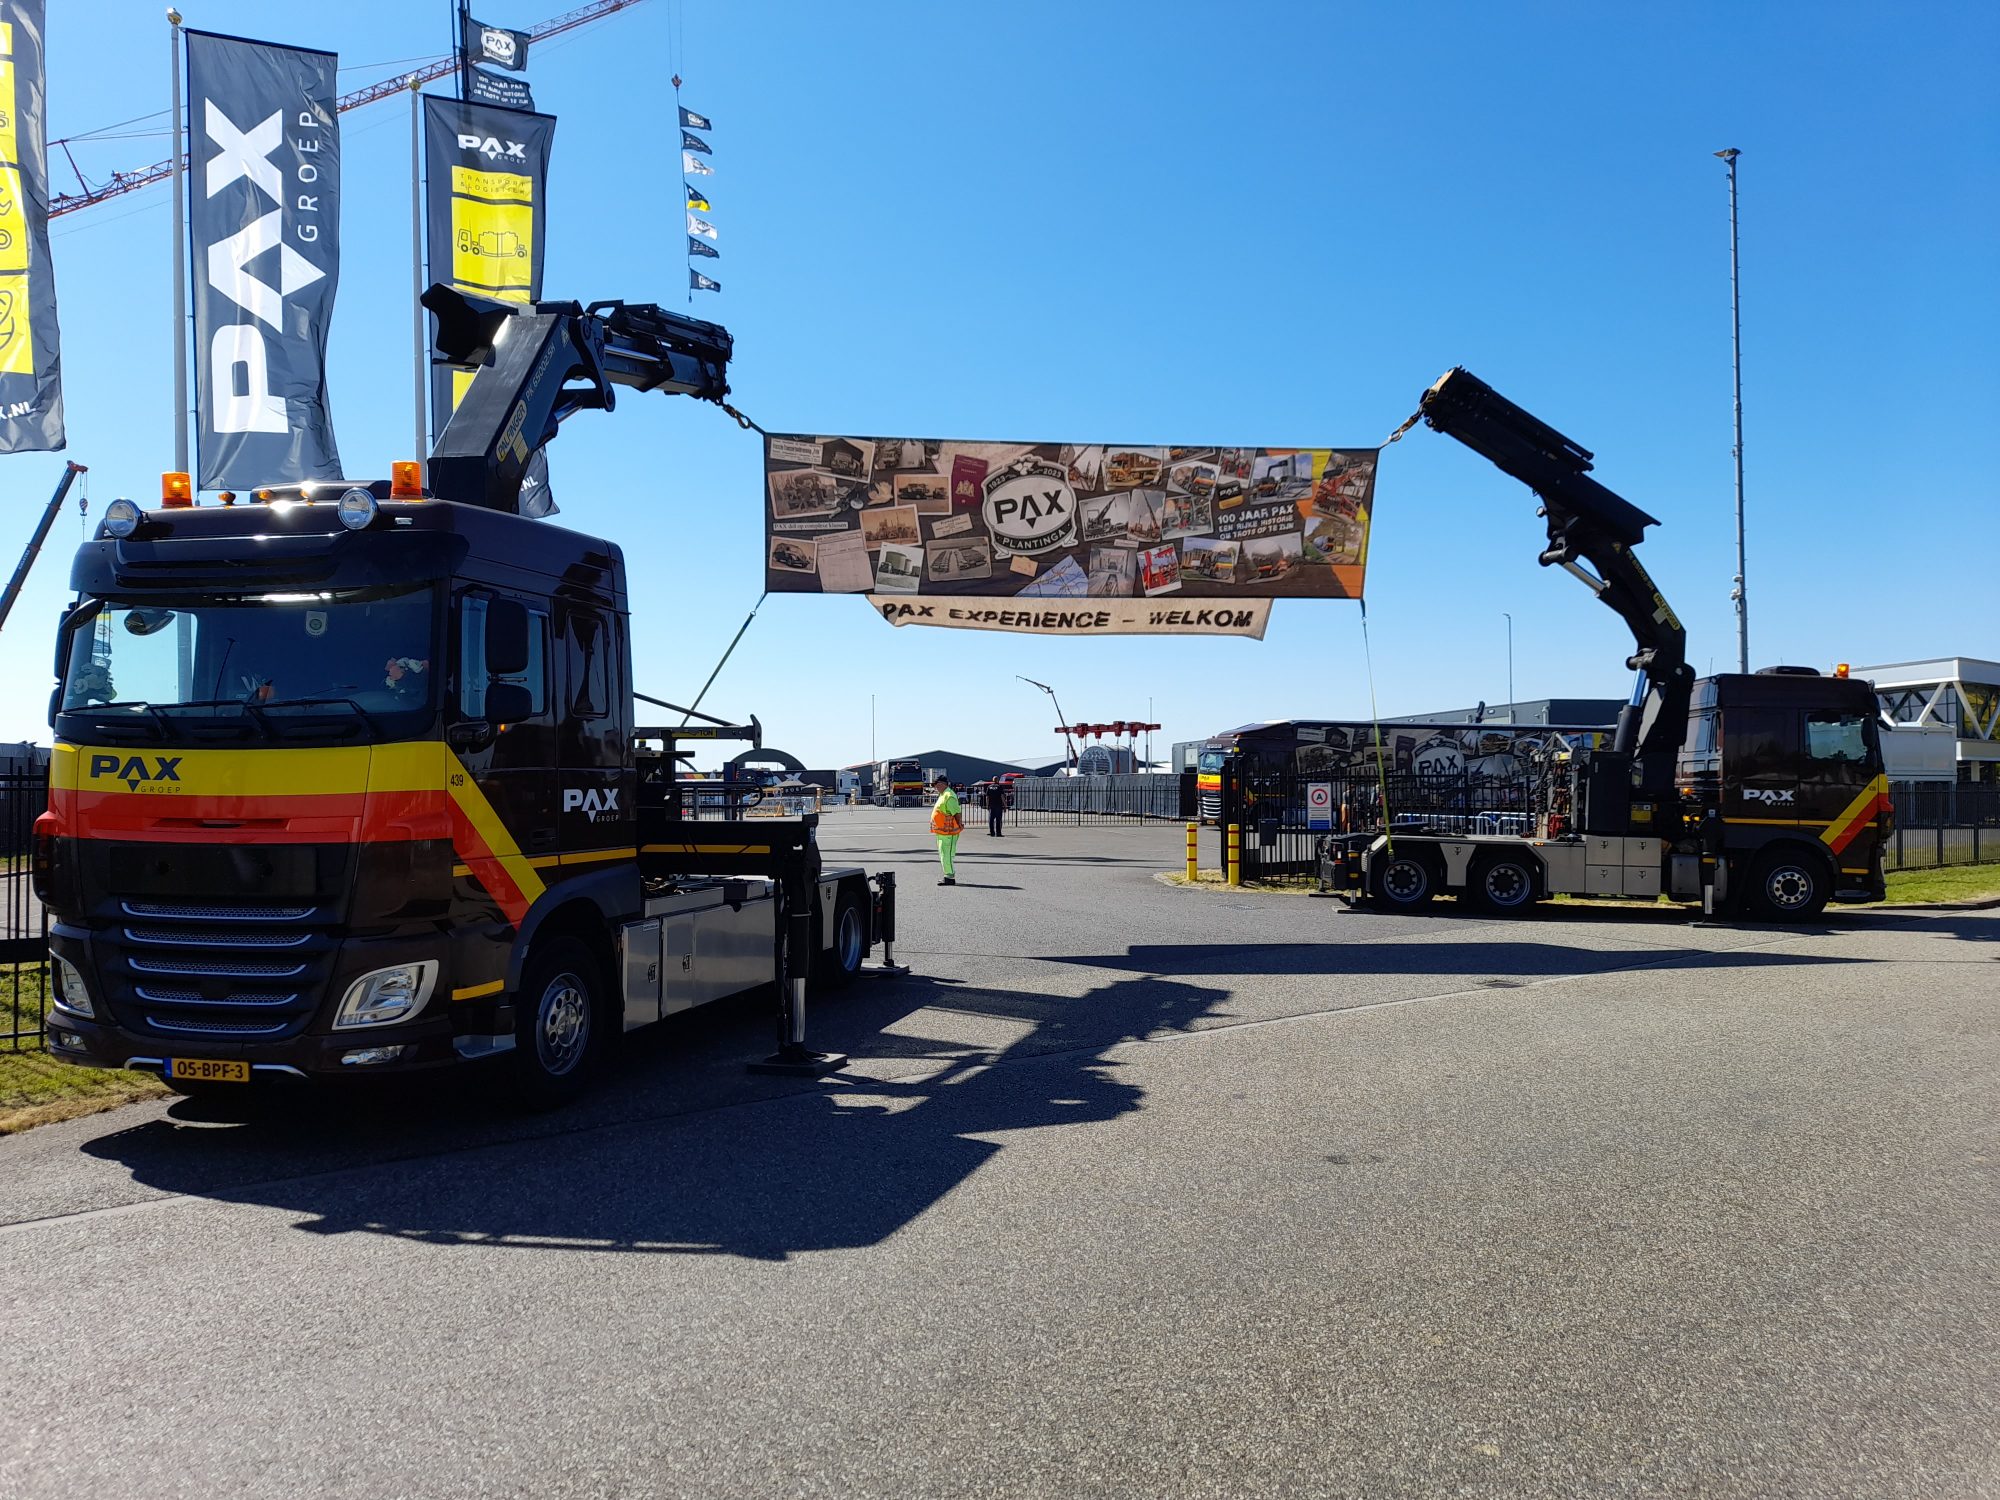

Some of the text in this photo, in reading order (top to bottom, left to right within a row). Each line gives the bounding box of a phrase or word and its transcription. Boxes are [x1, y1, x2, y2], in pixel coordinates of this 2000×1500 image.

[485, 35, 512, 51] PAX
[457, 134, 526, 160] PAX
[497, 154, 526, 164] GROEP
[298, 111, 319, 242] GROEP
[205, 97, 326, 434] PAX
[497, 404, 526, 459] PALFINGER
[1043, 467, 1062, 477] 2023
[988, 475, 1006, 490] 1923
[993, 489, 1066, 529] PAX
[1217, 504, 1295, 524] 100 JAAR PAX
[1002, 529, 1067, 550] PLANTINGA
[882, 603, 936, 621] PAX
[949, 608, 1110, 628] EXPERIENCE
[1149, 609, 1254, 628] WELKOM
[90, 754, 184, 792] PAX
[450, 774, 464, 787] 439
[140, 785, 182, 794] GROEP
[1316, 793, 1324, 801] A
[1743, 789, 1795, 806] PAX
[563, 788, 619, 823] PAX
[596, 814, 621, 823] GROEP
[177, 1061, 243, 1079] 05-BPF-3
